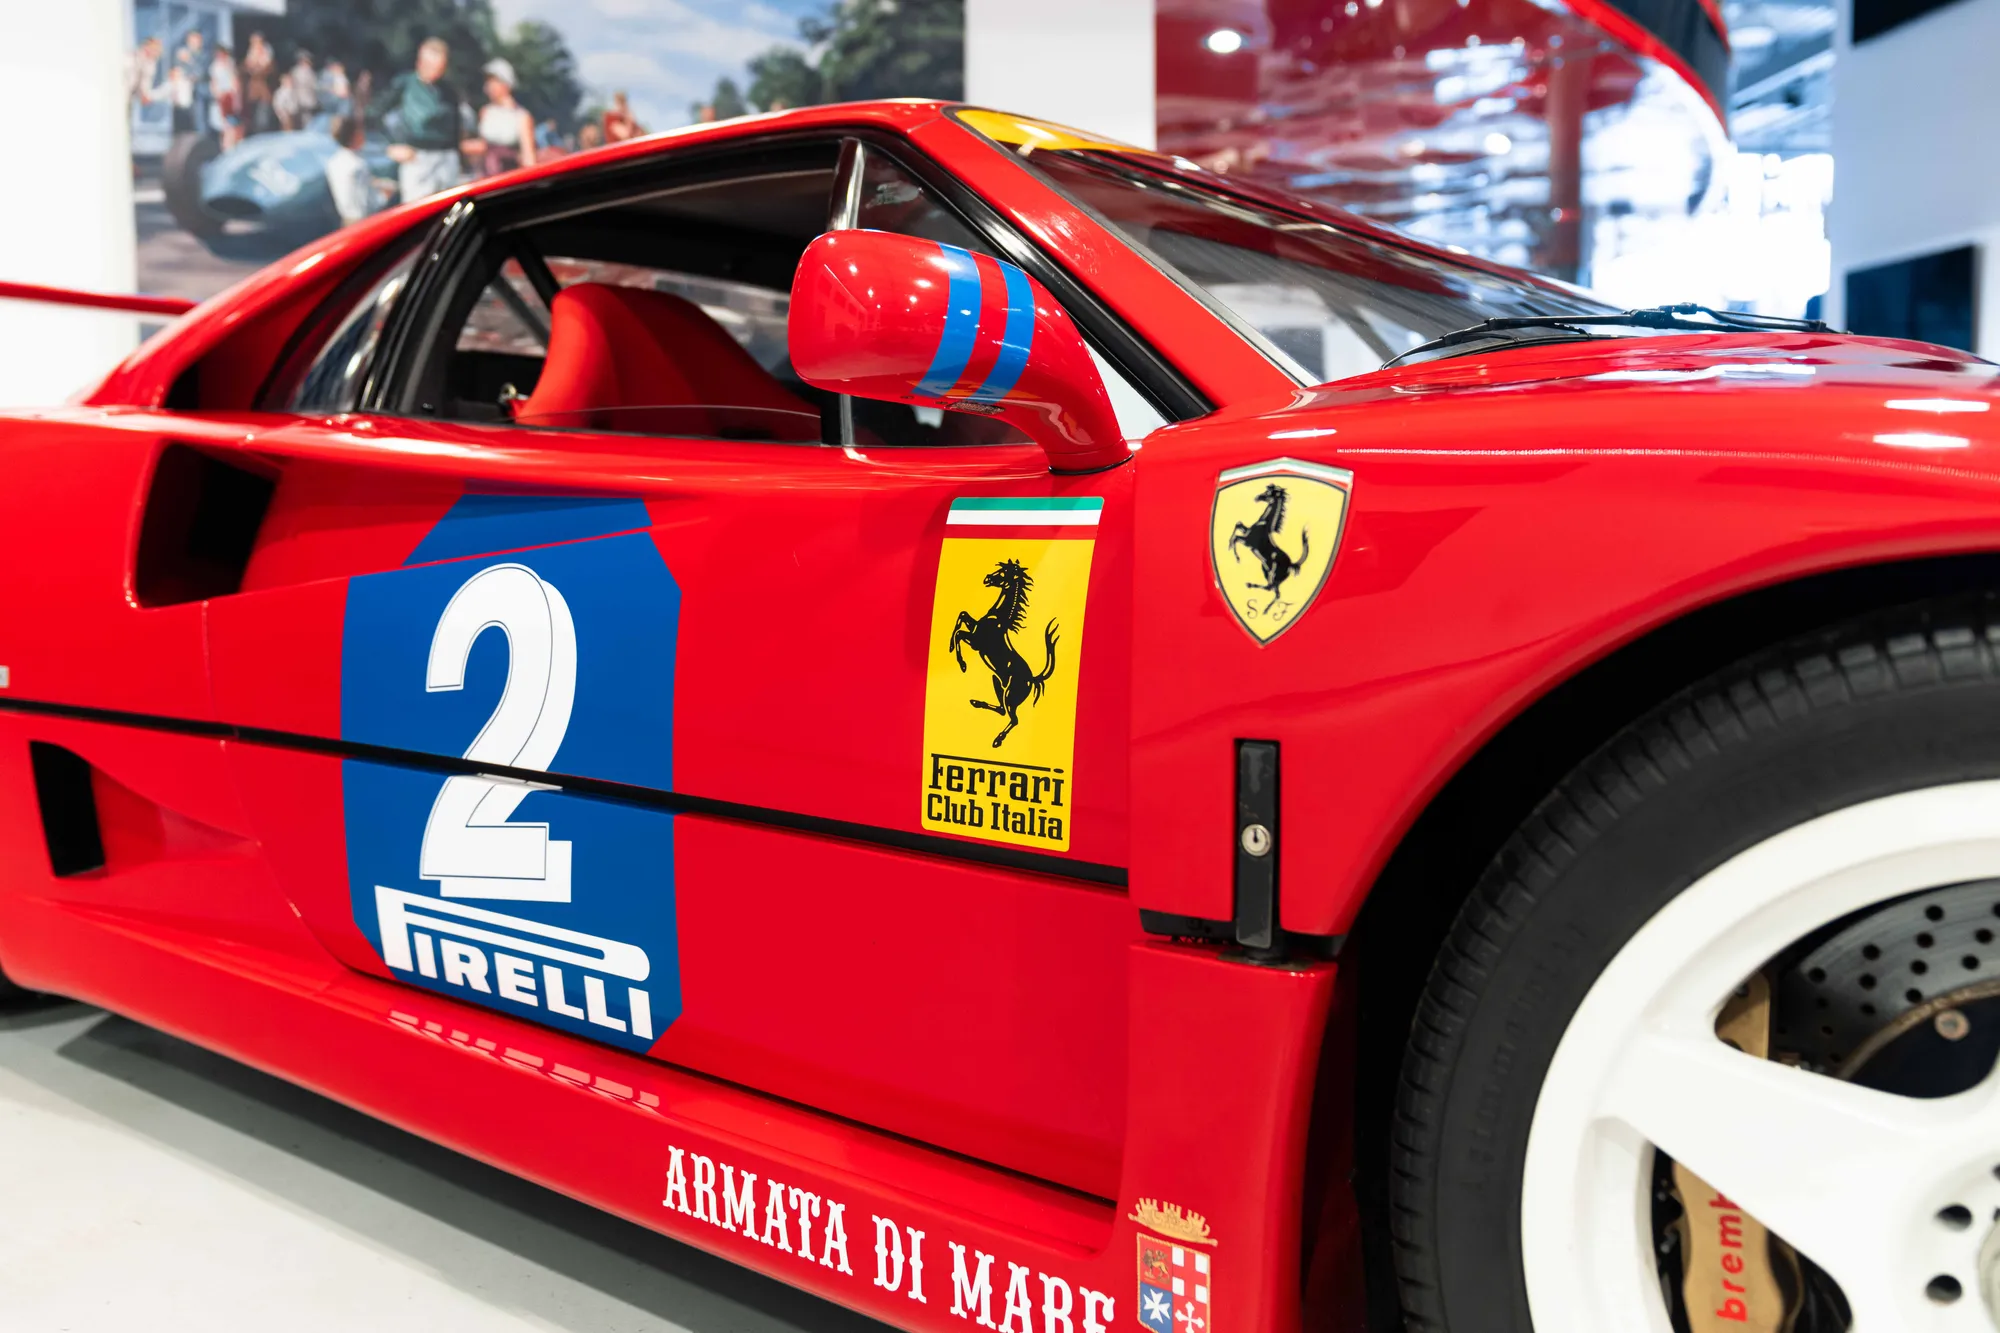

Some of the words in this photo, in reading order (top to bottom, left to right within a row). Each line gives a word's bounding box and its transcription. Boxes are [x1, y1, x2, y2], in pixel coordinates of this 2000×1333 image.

[1247, 599, 1258, 620] S
[420, 563, 577, 903] 2
[929, 753, 1064, 806] Ferrari
[928, 793, 984, 828] Club
[991, 802, 1063, 841] Italia
[375, 886, 653, 1040] PIRELLI
[663, 1145, 853, 1276] ARMATA
[872, 1214, 927, 1304] DI
